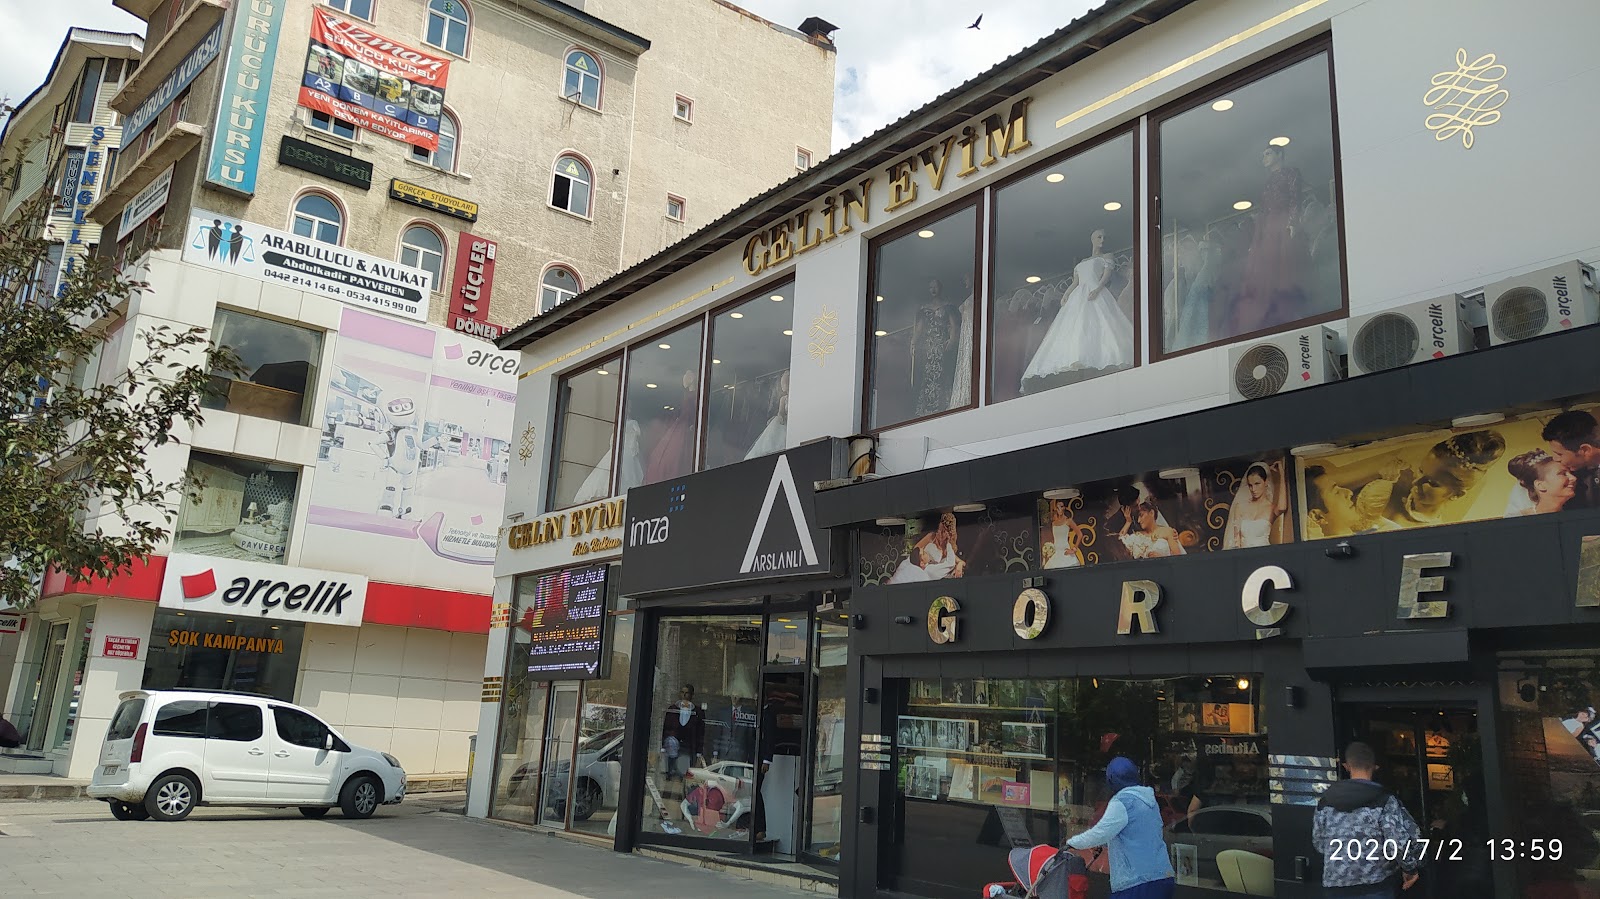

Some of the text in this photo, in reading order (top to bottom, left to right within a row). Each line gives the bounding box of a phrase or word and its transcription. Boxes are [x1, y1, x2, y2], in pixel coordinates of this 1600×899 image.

[323, 32, 437, 82] SÜRÜCÜ KURSU
[130, 67, 178, 134] SÜRÜCÜ
[177, 23, 222, 88] KURSU
[314, 77, 332, 90] A2
[353, 92, 361, 101] B
[332, 99, 369, 117] DÖNEM
[371, 113, 435, 141] KAYITLARIMIZ
[334, 109, 369, 127] DEVAM
[384, 105, 396, 114] C
[418, 116, 428, 125] D
[220, 94, 260, 184] KURSU
[285, 144, 329, 169] DERSİ
[62, 159, 80, 207] HUKUK
[397, 181, 427, 199] GÖRÇEK
[260, 233, 428, 288] ARABULUCU & AVUKAT
[282, 257, 405, 297] Abdulkadir PAYVEREN
[461, 240, 488, 302] ÜÇLER
[264, 268, 291, 282] 0442
[292, 276, 312, 288] 214
[314, 281, 326, 292] 14
[346, 289, 371, 303] 0534
[372, 295, 391, 308] 415
[392, 300, 404, 311] 99
[405, 304, 417, 314] 00
[1552, 275, 1567, 317] arçelik
[455, 316, 498, 340] DÖNER
[1428, 302, 1444, 349] arçelik
[1301, 334, 1310, 370] arçelik
[241, 539, 287, 554] PAYVEREN
[629, 515, 670, 548] imza
[752, 550, 802, 573] ARSLANLI
[222, 576, 353, 617] arçelik
[168, 629, 284, 654] ŞOK KAMPANYA
